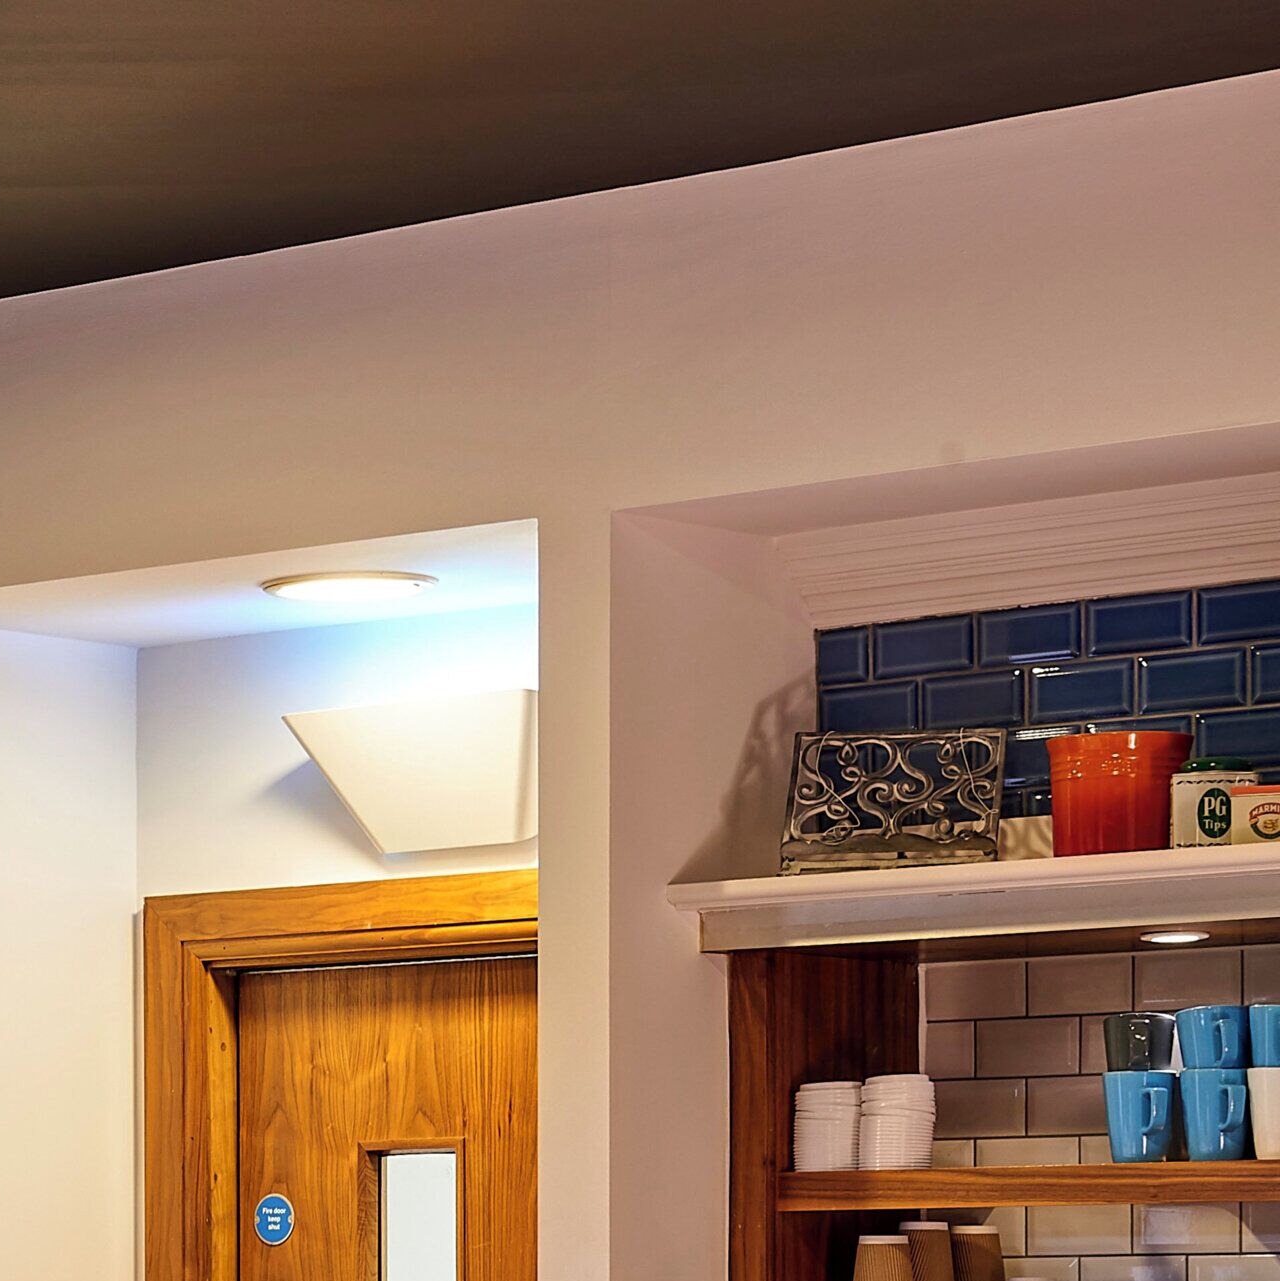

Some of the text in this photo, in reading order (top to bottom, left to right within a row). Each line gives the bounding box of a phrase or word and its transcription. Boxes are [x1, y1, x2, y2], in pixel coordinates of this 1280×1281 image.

[1203, 796, 1227, 817] PG
[1203, 819, 1227, 832] Tips
[268, 1215, 281, 1223] keep
